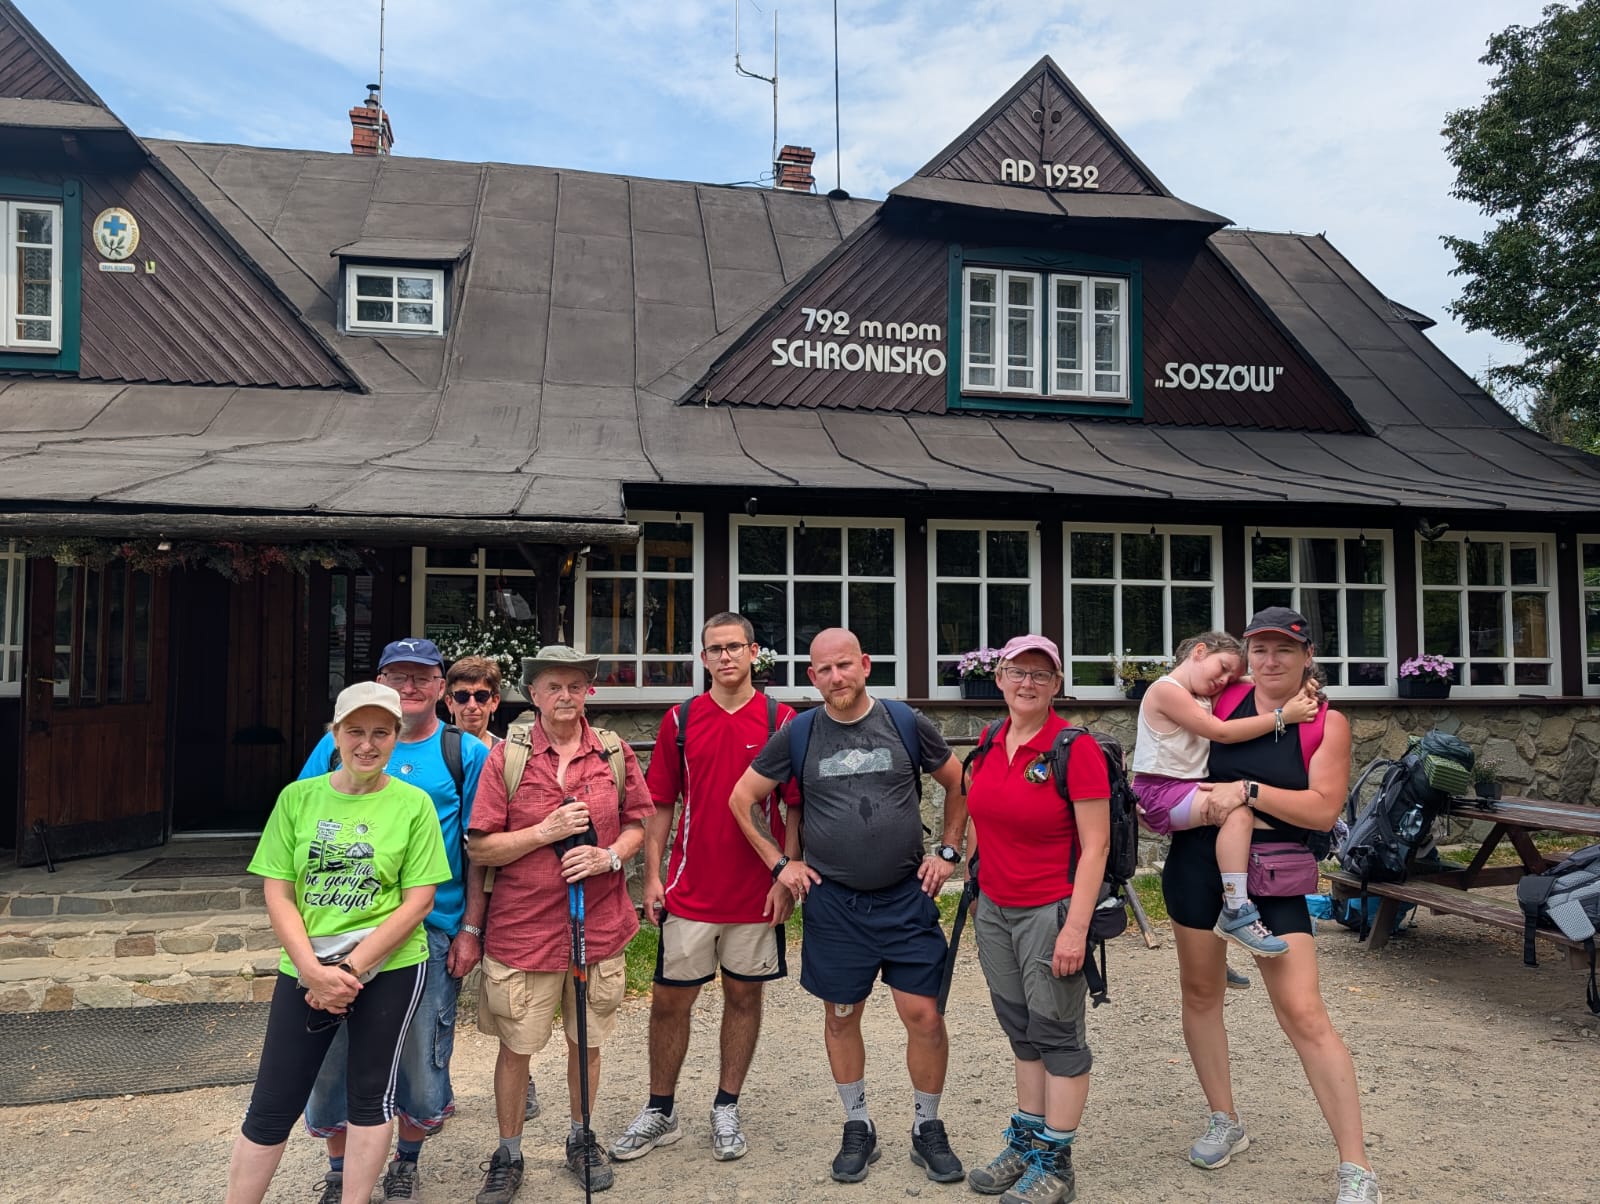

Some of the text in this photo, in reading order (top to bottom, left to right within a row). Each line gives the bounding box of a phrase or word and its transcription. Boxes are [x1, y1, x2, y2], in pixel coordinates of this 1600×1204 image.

[1001, 158, 1099, 188] AD 1932
[801, 307, 850, 335] 792
[771, 338, 947, 376] SCHRONISKO
